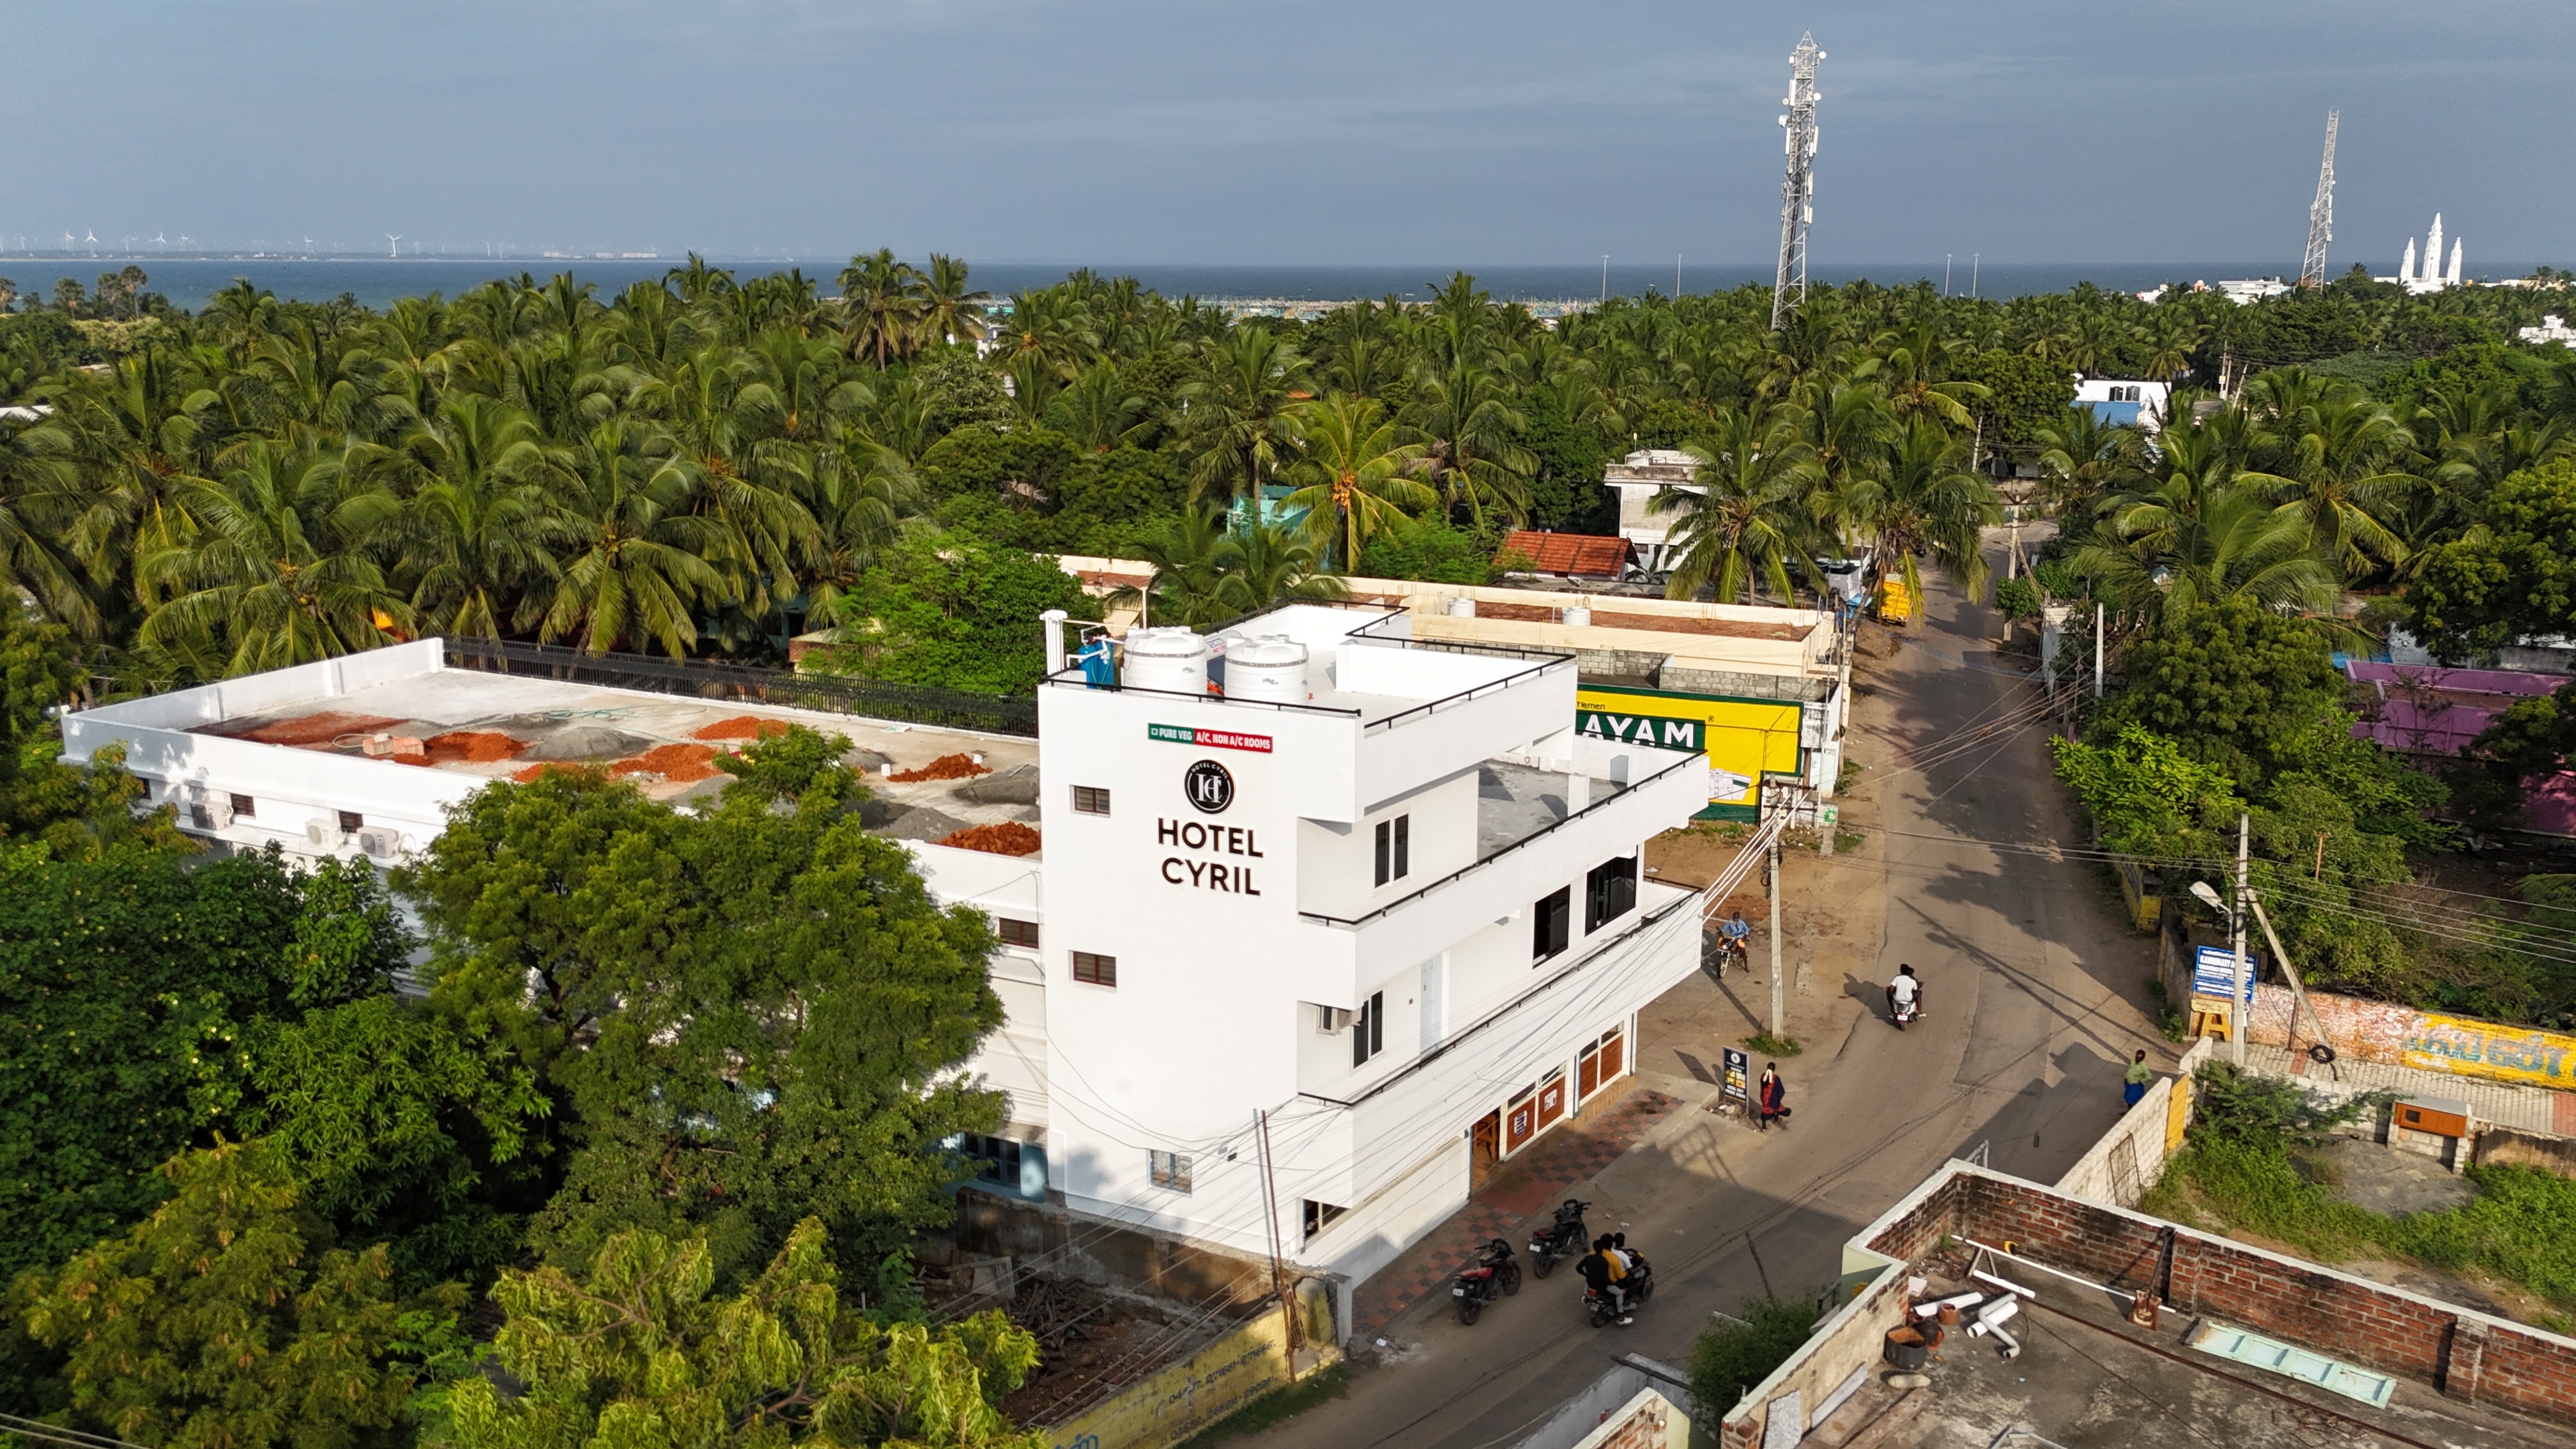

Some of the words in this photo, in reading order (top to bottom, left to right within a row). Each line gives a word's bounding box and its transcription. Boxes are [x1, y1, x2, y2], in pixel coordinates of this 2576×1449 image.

[1159, 727, 1177, 739] PURE
[1178, 730, 1192, 741] VEG
[1196, 731, 1211, 744] A/C,
[1212, 734, 1230, 745] NON
[1229, 735, 1243, 747] A/C
[1244, 737, 1271, 750] ROOMS
[1582, 714, 1694, 748] AYAM
[1158, 817, 1264, 858] HOTEL
[1162, 857, 1261, 896] CYRIL
